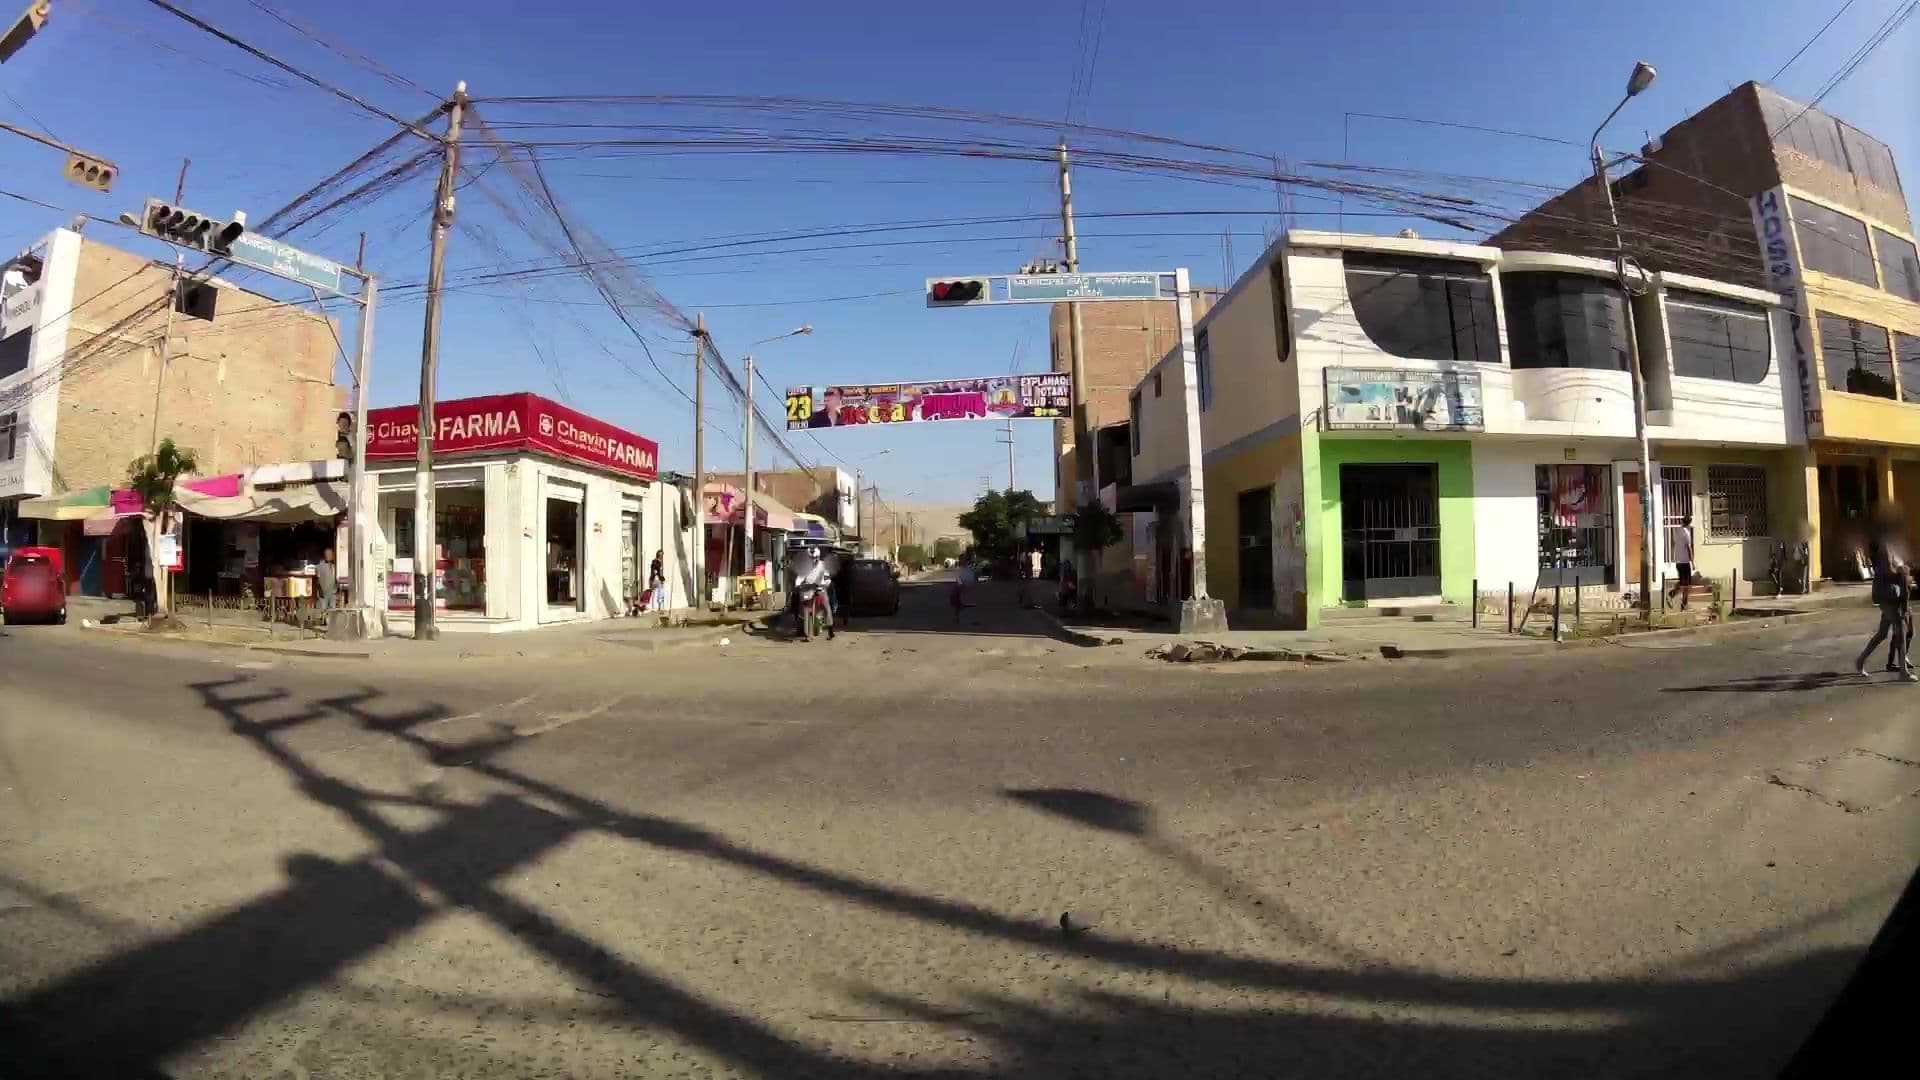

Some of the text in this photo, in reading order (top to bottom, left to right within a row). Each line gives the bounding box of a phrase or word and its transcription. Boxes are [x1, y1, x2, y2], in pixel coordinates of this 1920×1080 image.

[786, 395, 812, 420] 23
[438, 410, 521, 442] FARMA
[557, 420, 607, 450] Chavin
[607, 438, 656, 472] FARMA
